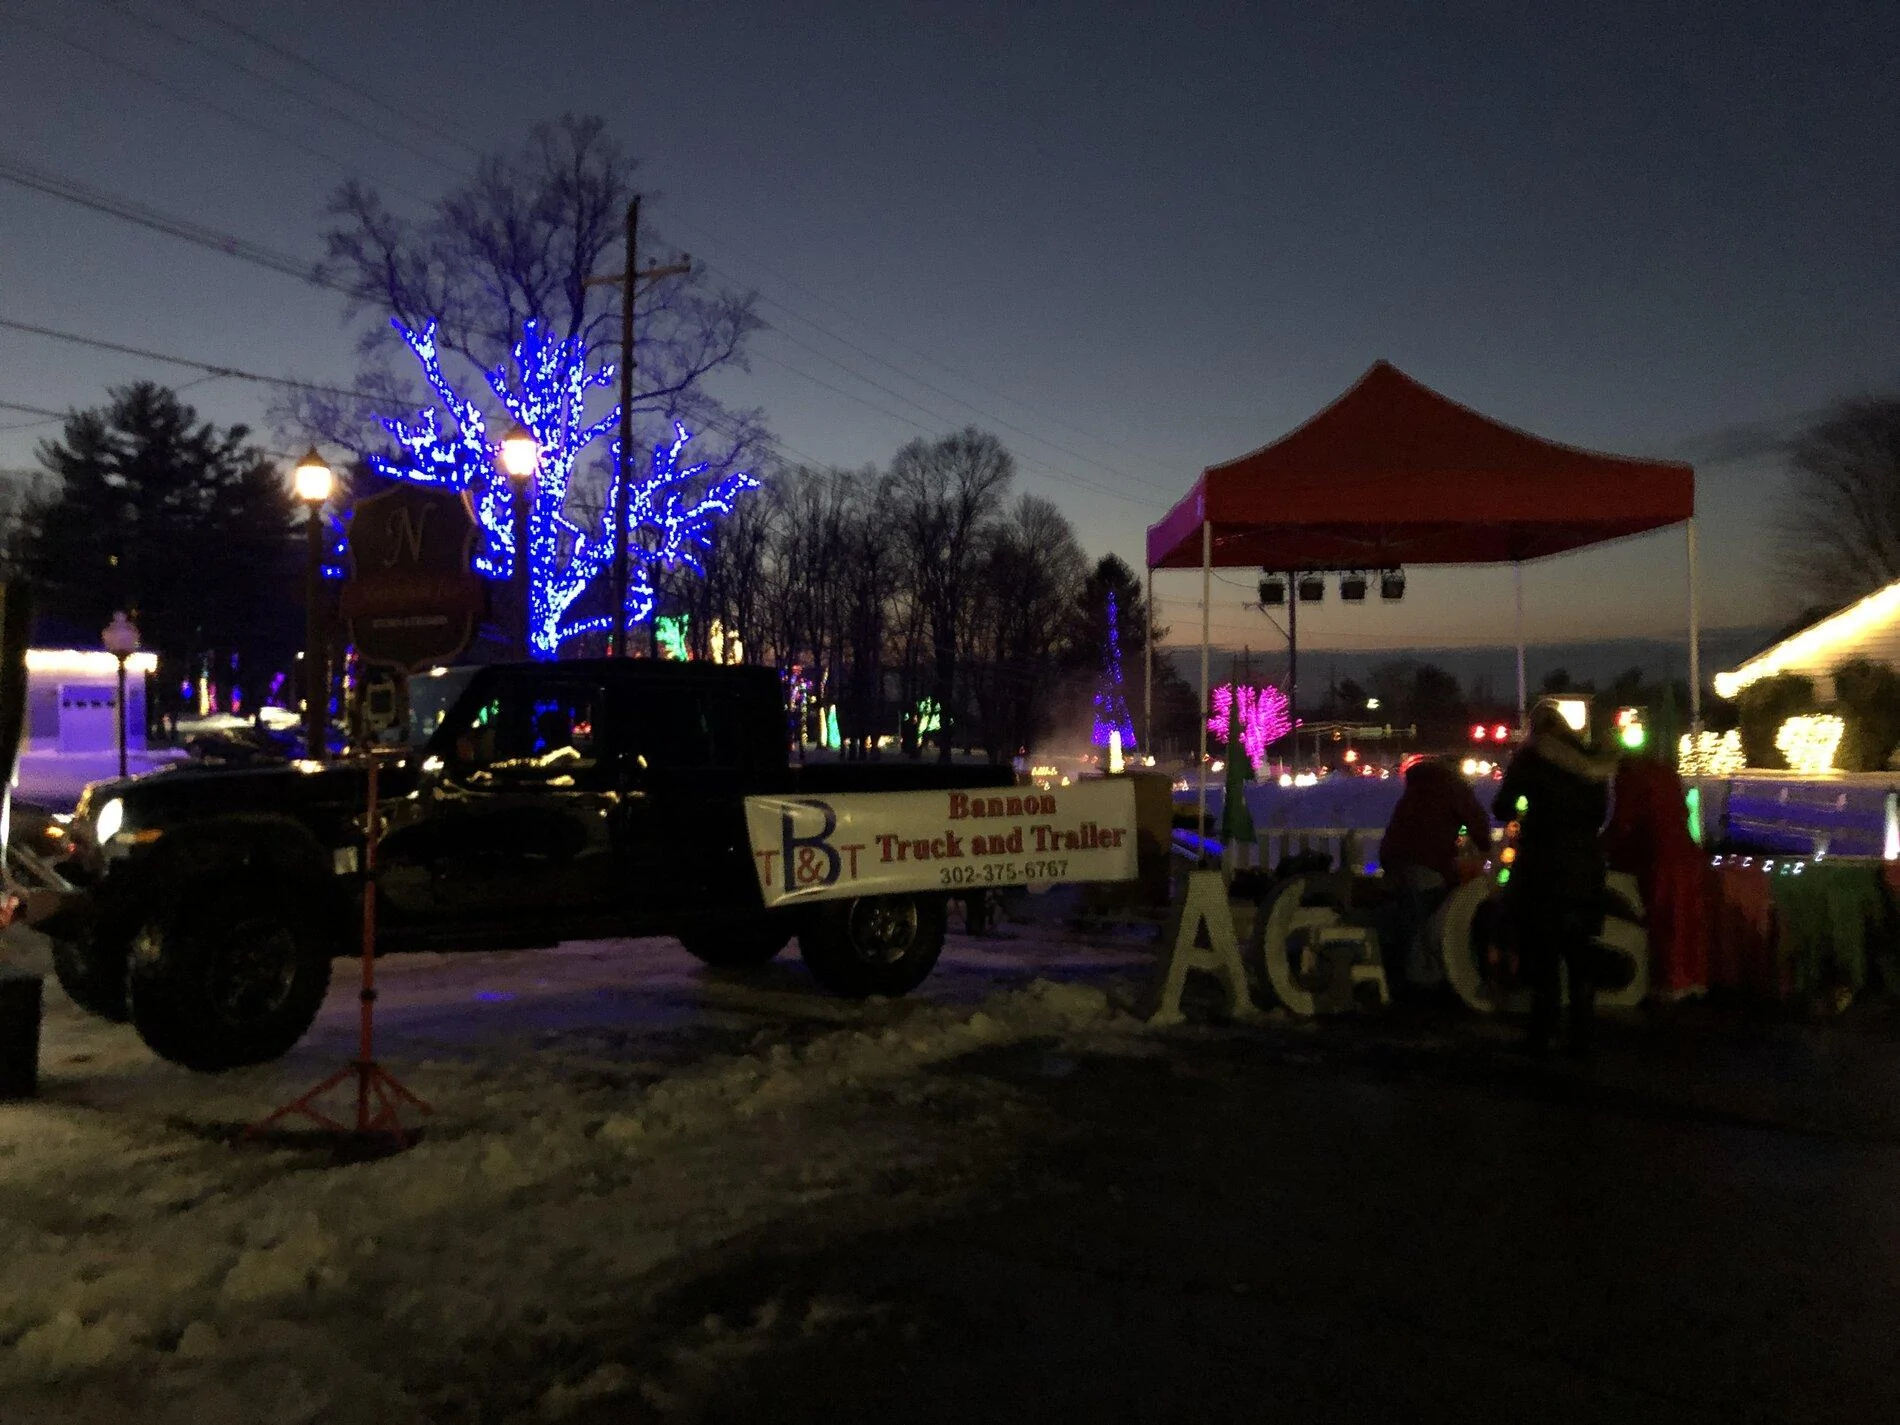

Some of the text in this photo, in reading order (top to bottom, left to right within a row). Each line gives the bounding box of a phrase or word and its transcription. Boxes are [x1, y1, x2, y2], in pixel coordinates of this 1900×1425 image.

[949, 792, 1056, 819] Bannon
[875, 821, 1127, 863] Truck and Trailer
[939, 859, 1069, 884] 302-375-6767
